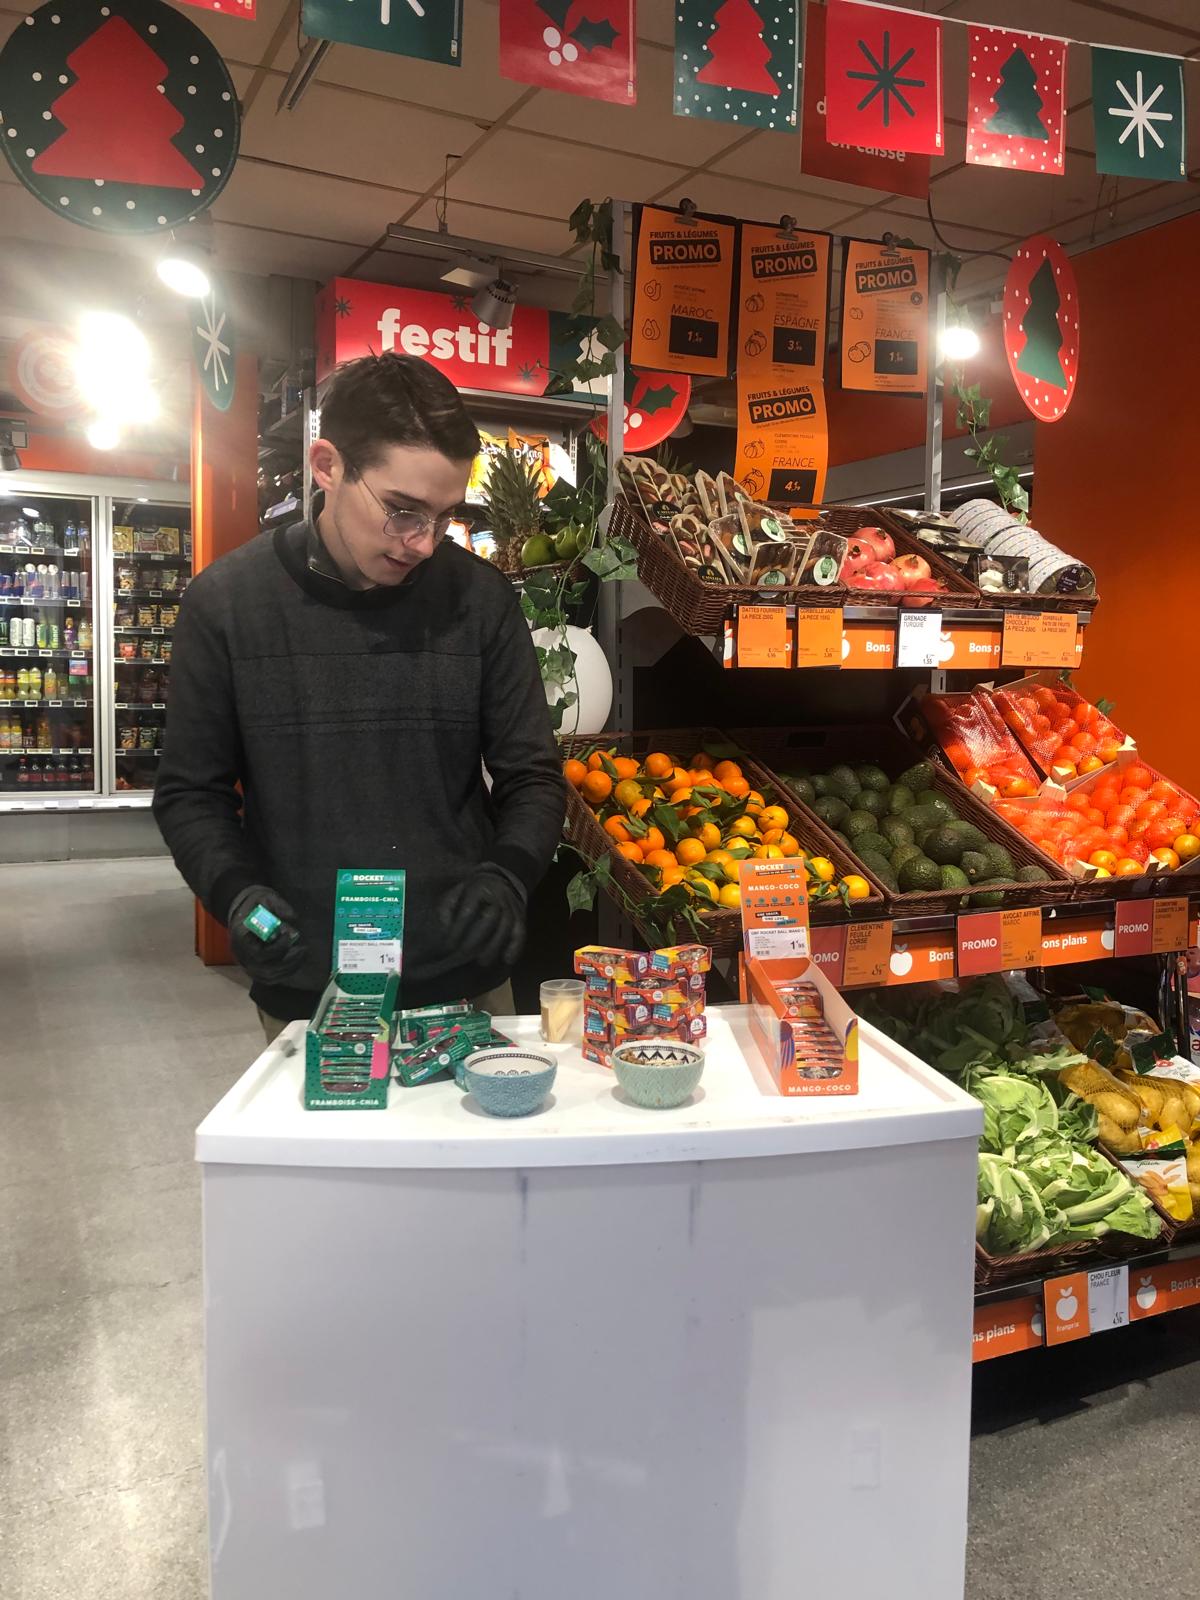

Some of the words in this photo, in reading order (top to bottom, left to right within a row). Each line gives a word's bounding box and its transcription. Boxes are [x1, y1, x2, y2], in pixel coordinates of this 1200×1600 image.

[650, 231, 675, 239] FRUITS
[653, 244, 717, 261] PROMO
[751, 245, 775, 254] FRUITS
[755, 255, 814, 275] PROMO
[856, 261, 877, 269] FRUITS
[858, 270, 913, 290] PROMO
[671, 304, 714, 319] MAROC
[774, 314, 819, 329] ESPAGNE
[377, 308, 513, 367] festif
[875, 328, 914, 340] FRANCE
[747, 390, 771, 400] FRUITS
[752, 398, 812, 420] PROMO
[772, 456, 815, 468] FRANCE
[865, 641, 891, 652] Bons
[969, 642, 992, 653] Bons
[748, 883, 800, 891] MANGO-COCO
[1003, 912, 1022, 920] AVOCAT
[850, 923, 884, 931] CLEMENTINE
[1118, 923, 1149, 934] PROMO
[962, 938, 998, 951] PROMO
[1042, 939, 1060, 949] ons
[1061, 935, 1088, 950] plans
[810, 952, 840, 964] OMO
[929, 950, 954, 962] Bons
[788, 1084, 851, 1093] MANGO-COCO
[310, 1098, 379, 1106] FRAMBOISE-CHIA
[1090, 1272, 1104, 1281] CHOU
[1105, 1268, 1121, 1278] FLEUR
[1090, 1279, 1110, 1289] FRANCE
[1171, 1278, 1194, 1292] Bons
[986, 1323, 1016, 1344] plans
